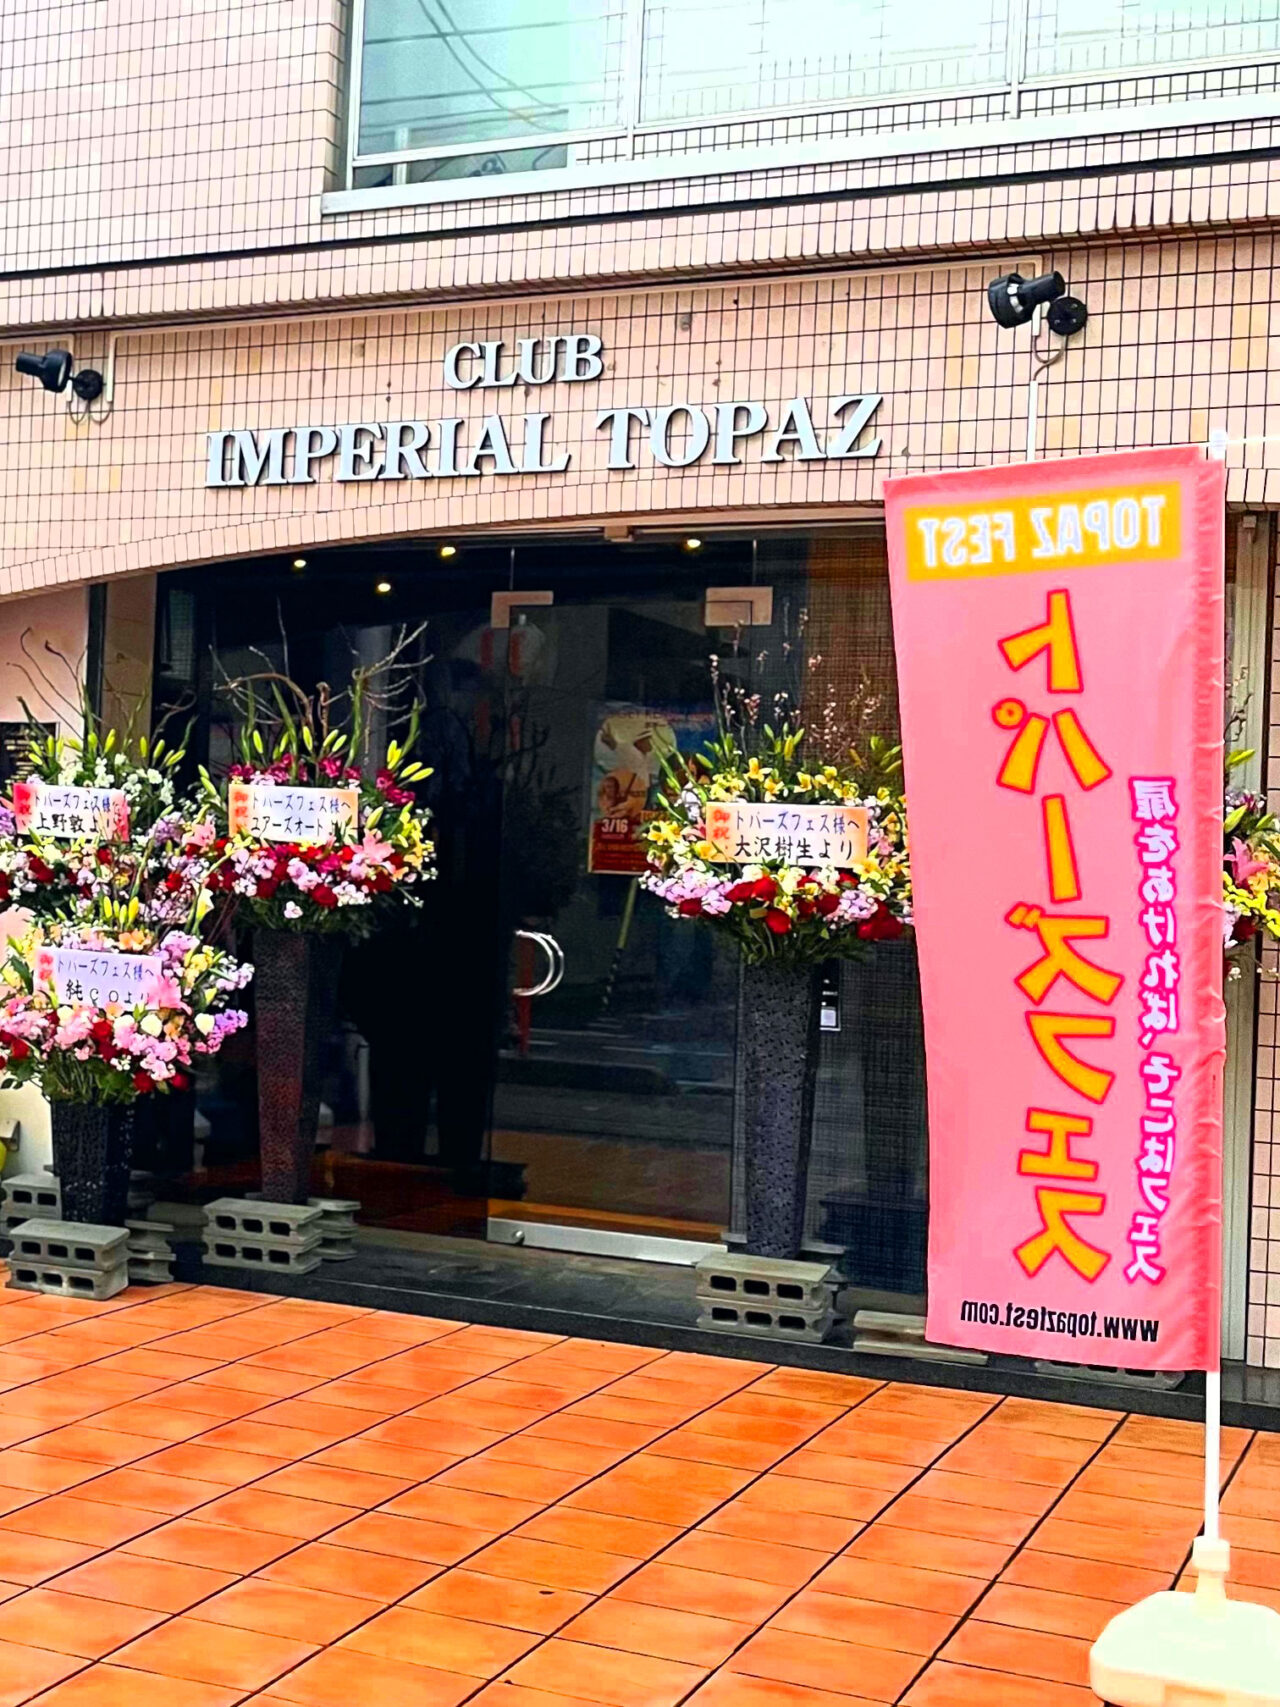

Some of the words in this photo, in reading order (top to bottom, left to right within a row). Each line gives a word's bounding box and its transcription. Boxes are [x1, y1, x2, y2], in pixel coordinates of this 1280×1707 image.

[443, 334, 604, 391] CLUB
[204, 412, 571, 489] IMPERIAL
[596, 393, 884, 472] TOPAZ
[601, 818, 629, 834] 3/16
[734, 833, 853, 861] 大沢樹生より
